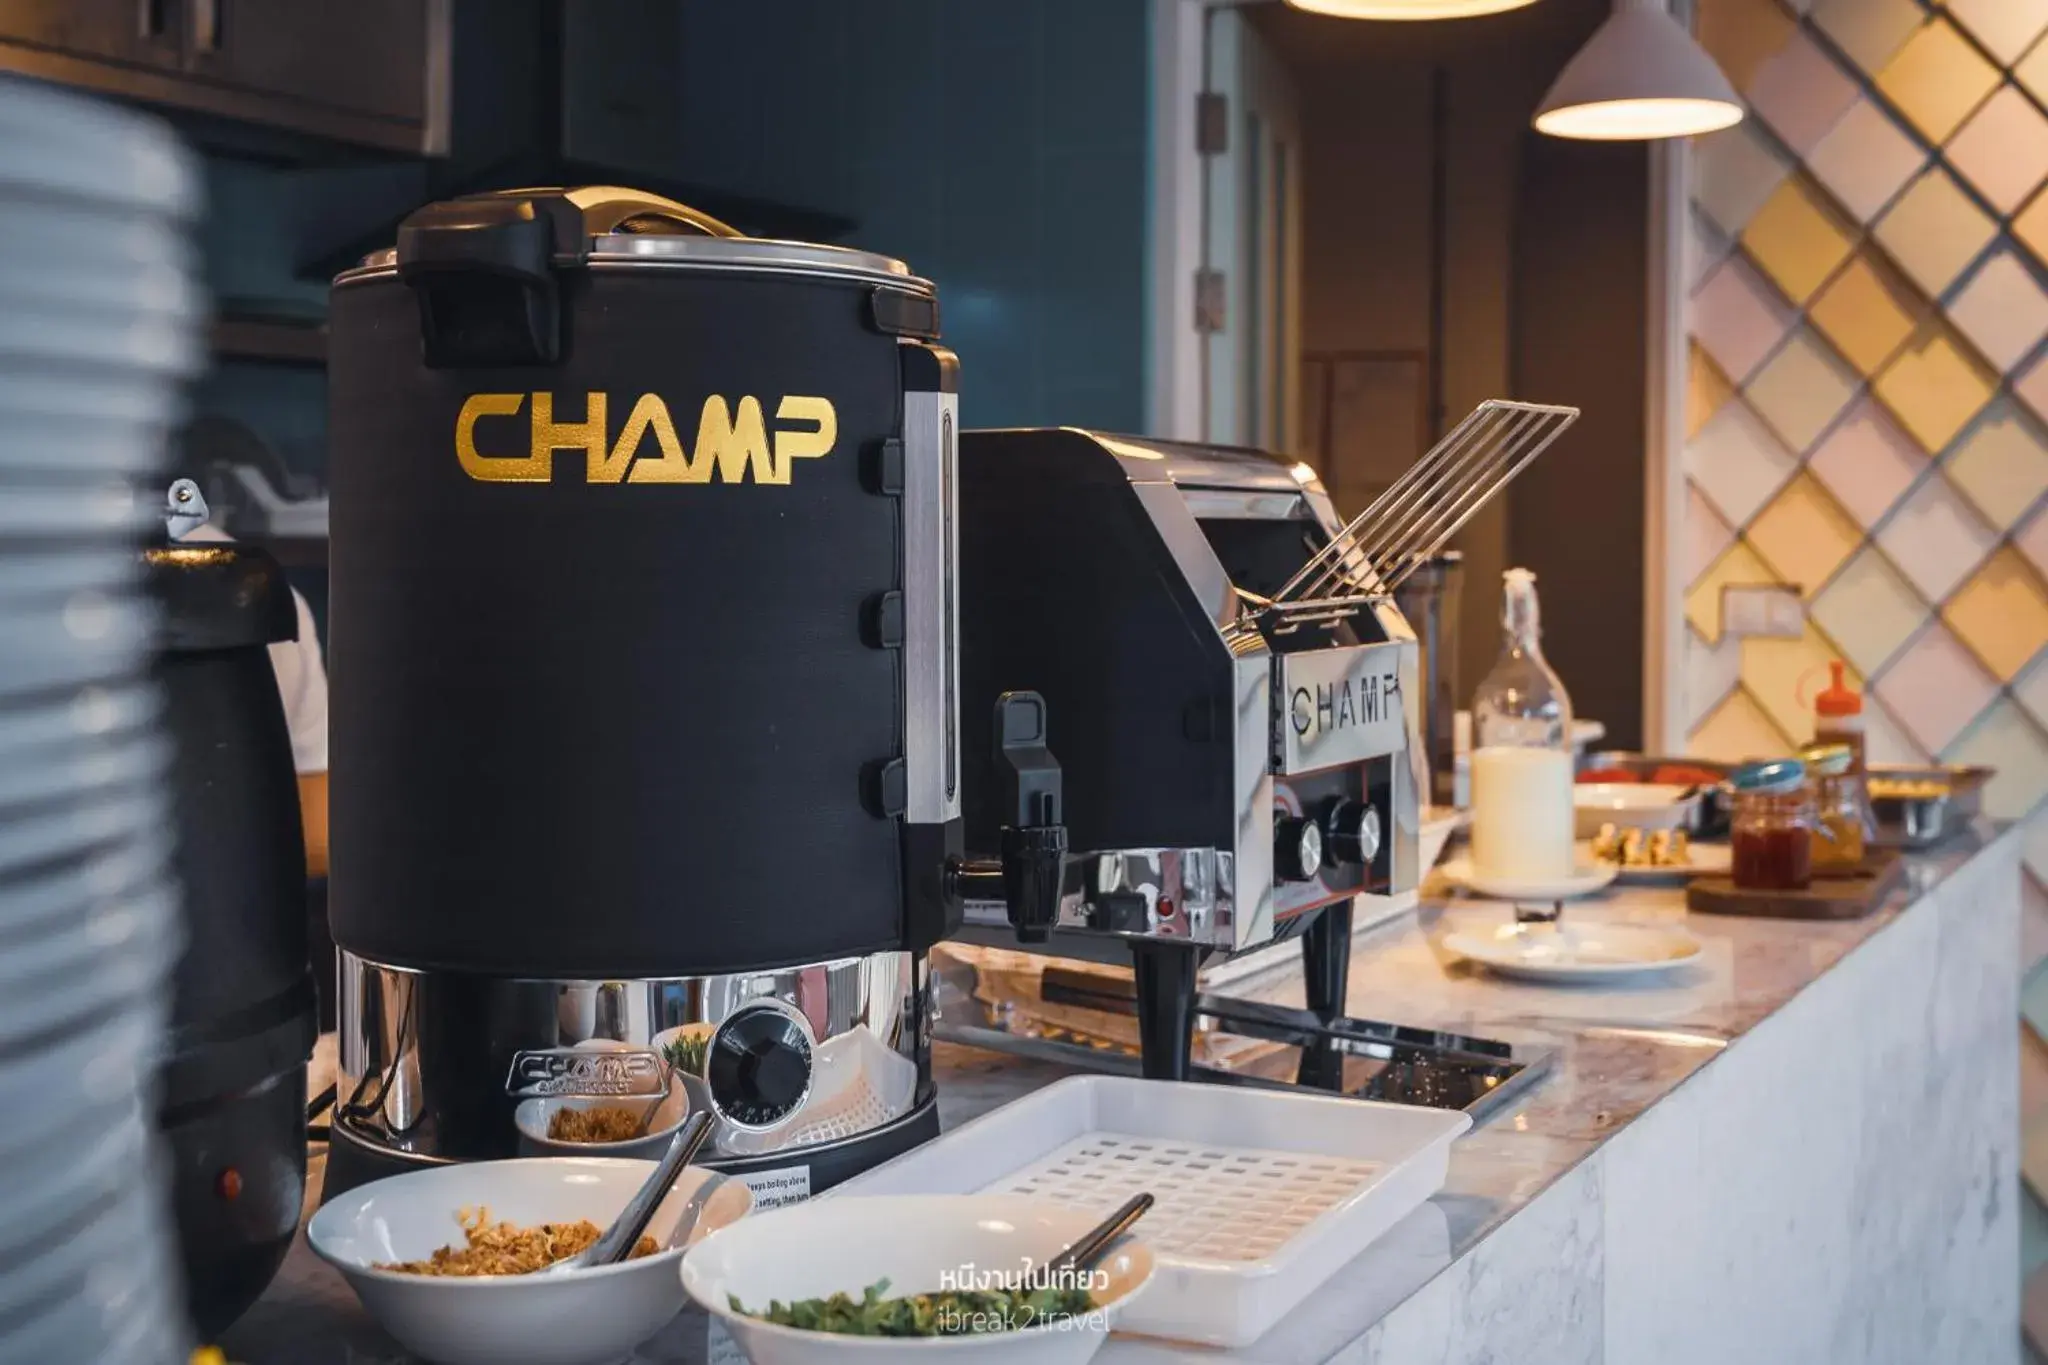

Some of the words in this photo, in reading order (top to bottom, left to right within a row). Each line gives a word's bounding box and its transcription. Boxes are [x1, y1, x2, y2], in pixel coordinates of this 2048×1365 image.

[456, 392, 838, 484] CHAMP
[1291, 674, 1400, 736] CHAMP
[520, 1056, 652, 1079] CHAMP
